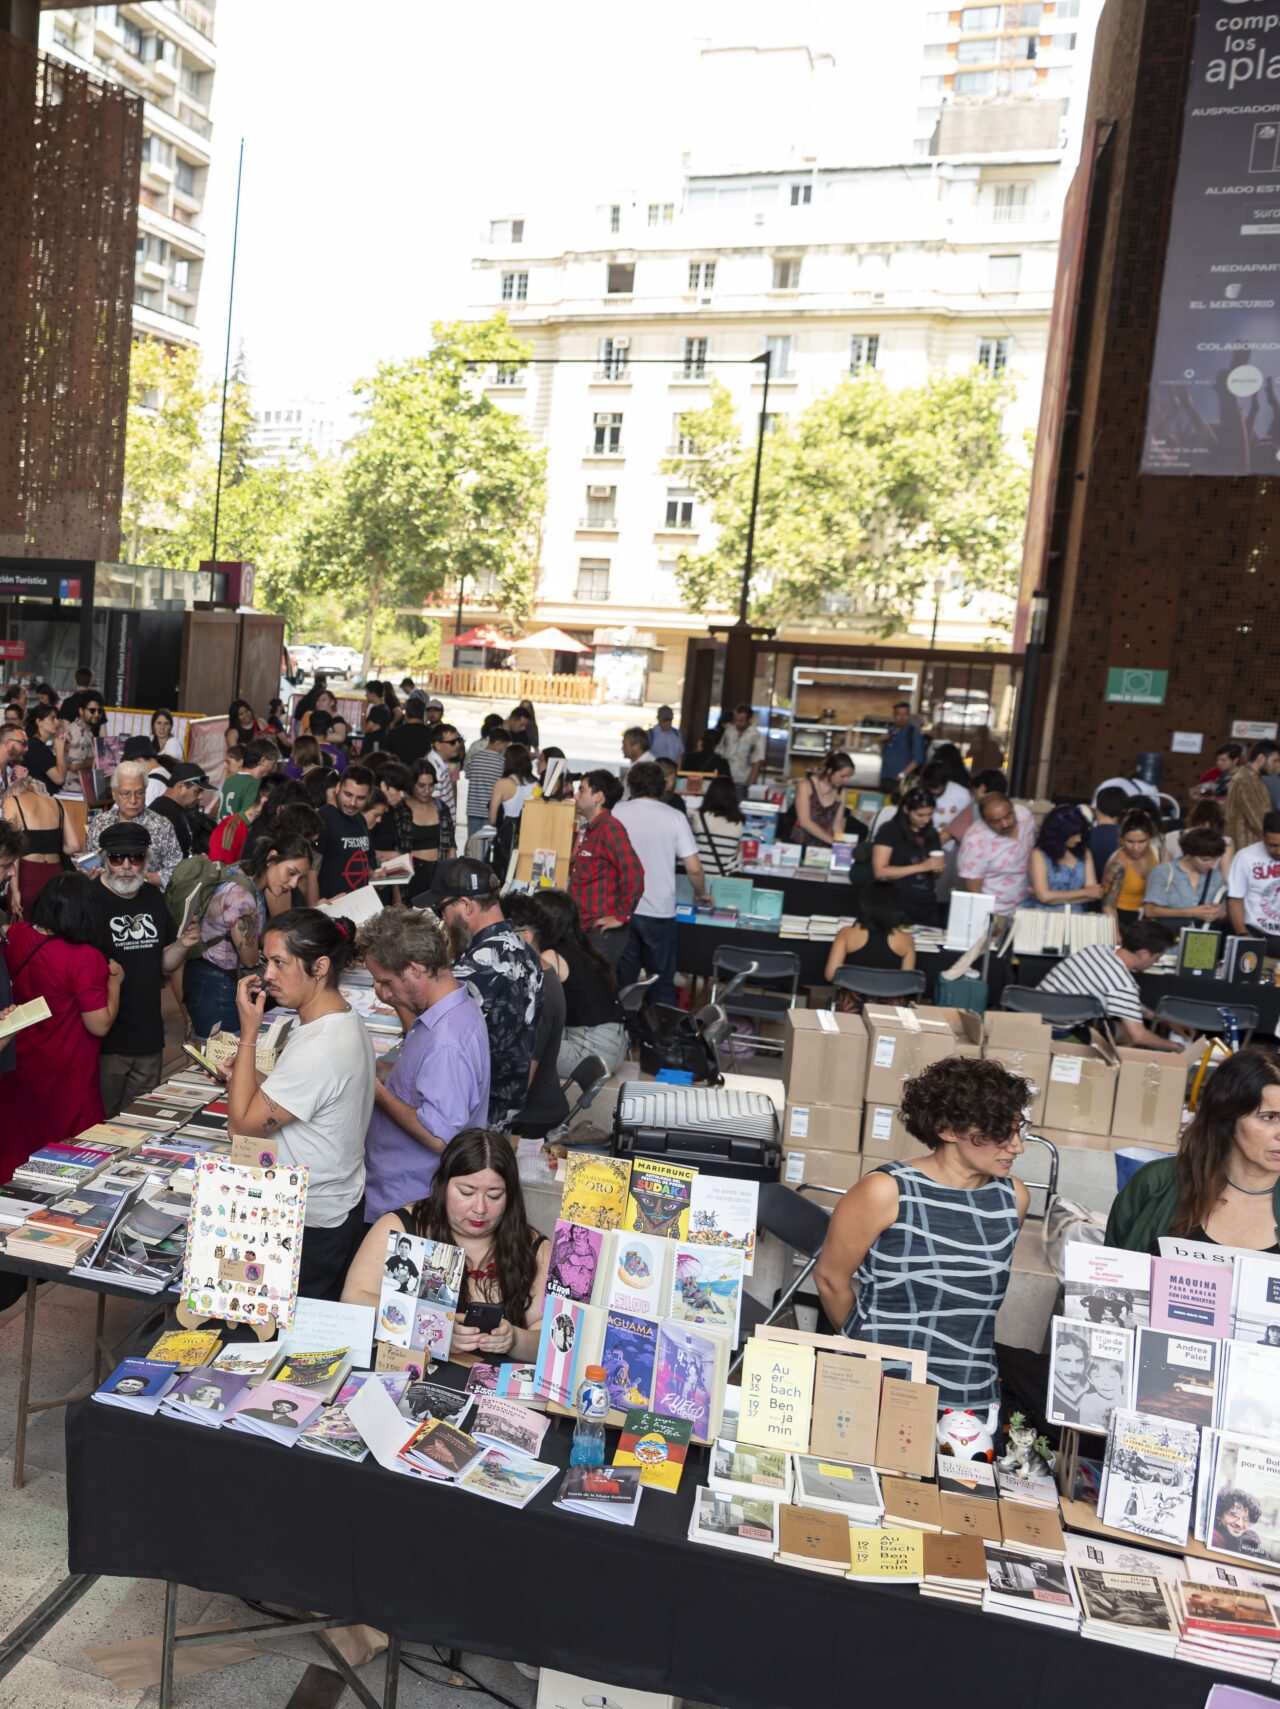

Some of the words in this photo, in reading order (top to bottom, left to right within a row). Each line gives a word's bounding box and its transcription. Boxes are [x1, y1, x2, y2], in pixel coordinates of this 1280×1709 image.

[1225, 35, 1256, 52] los
[1205, 185, 1254, 195] ALIADO
[1190, 301, 1206, 309] EL
[1209, 300, 1275, 309] MERCURIO
[109, 913, 158, 942] SOS
[637, 1162, 692, 1179] MARIFRUNC
[637, 1179, 688, 1199] SUDAKA
[1169, 1285, 1187, 1293] PARA
[1189, 1288, 1217, 1298] HABLAR
[1190, 1295, 1216, 1305] MUERTOS
[1099, 1343, 1122, 1354] Perry
[1176, 1343, 1208, 1354] Andrea
[1185, 1352, 1207, 1362] Palet
[772, 1363, 790, 1375] Au
[750, 1373, 761, 1384] 19
[771, 1374, 783, 1383] er
[749, 1383, 760, 1392] 35
[771, 1383, 801, 1398] bach
[749, 1399, 760, 1410] 19
[769, 1397, 794, 1412] Ben
[747, 1409, 758, 1417] 37
[782, 1412, 793, 1424] ja
[768, 1424, 792, 1436] min
